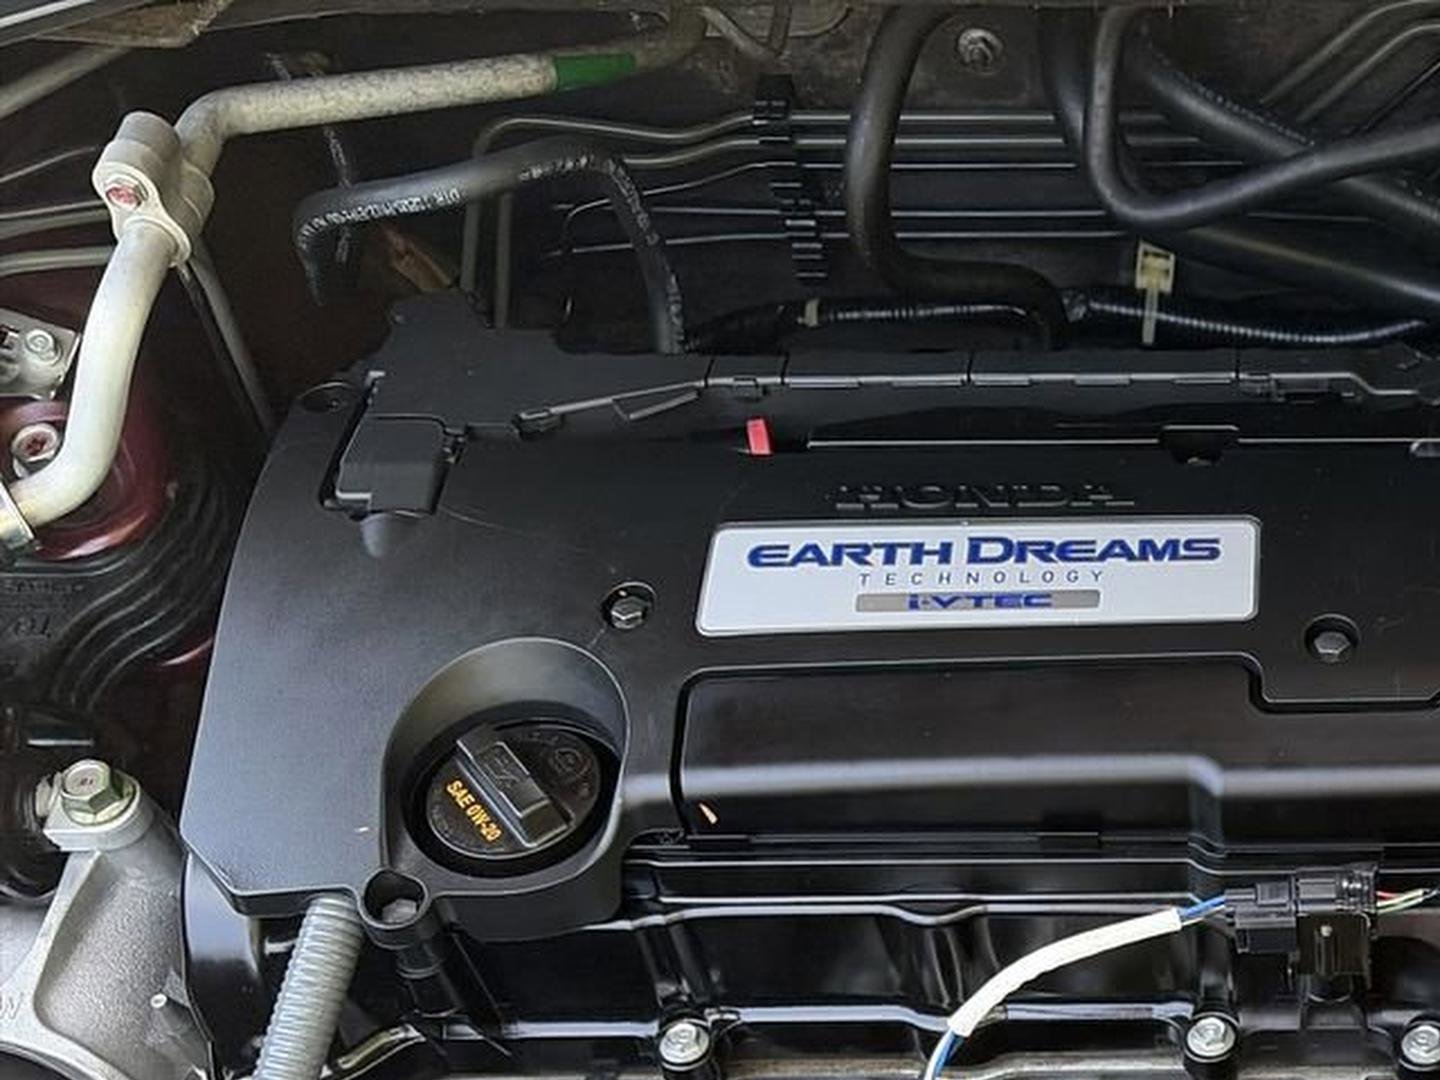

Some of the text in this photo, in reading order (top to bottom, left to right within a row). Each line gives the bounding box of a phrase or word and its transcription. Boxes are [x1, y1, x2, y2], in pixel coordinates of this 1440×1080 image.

[835, 485, 1136, 511] HONDA
[747, 536, 1223, 568] EARTH DREAMS
[859, 569, 1106, 587] TECHNOLOGY
[446, 780, 502, 842] SAE 0W-20
